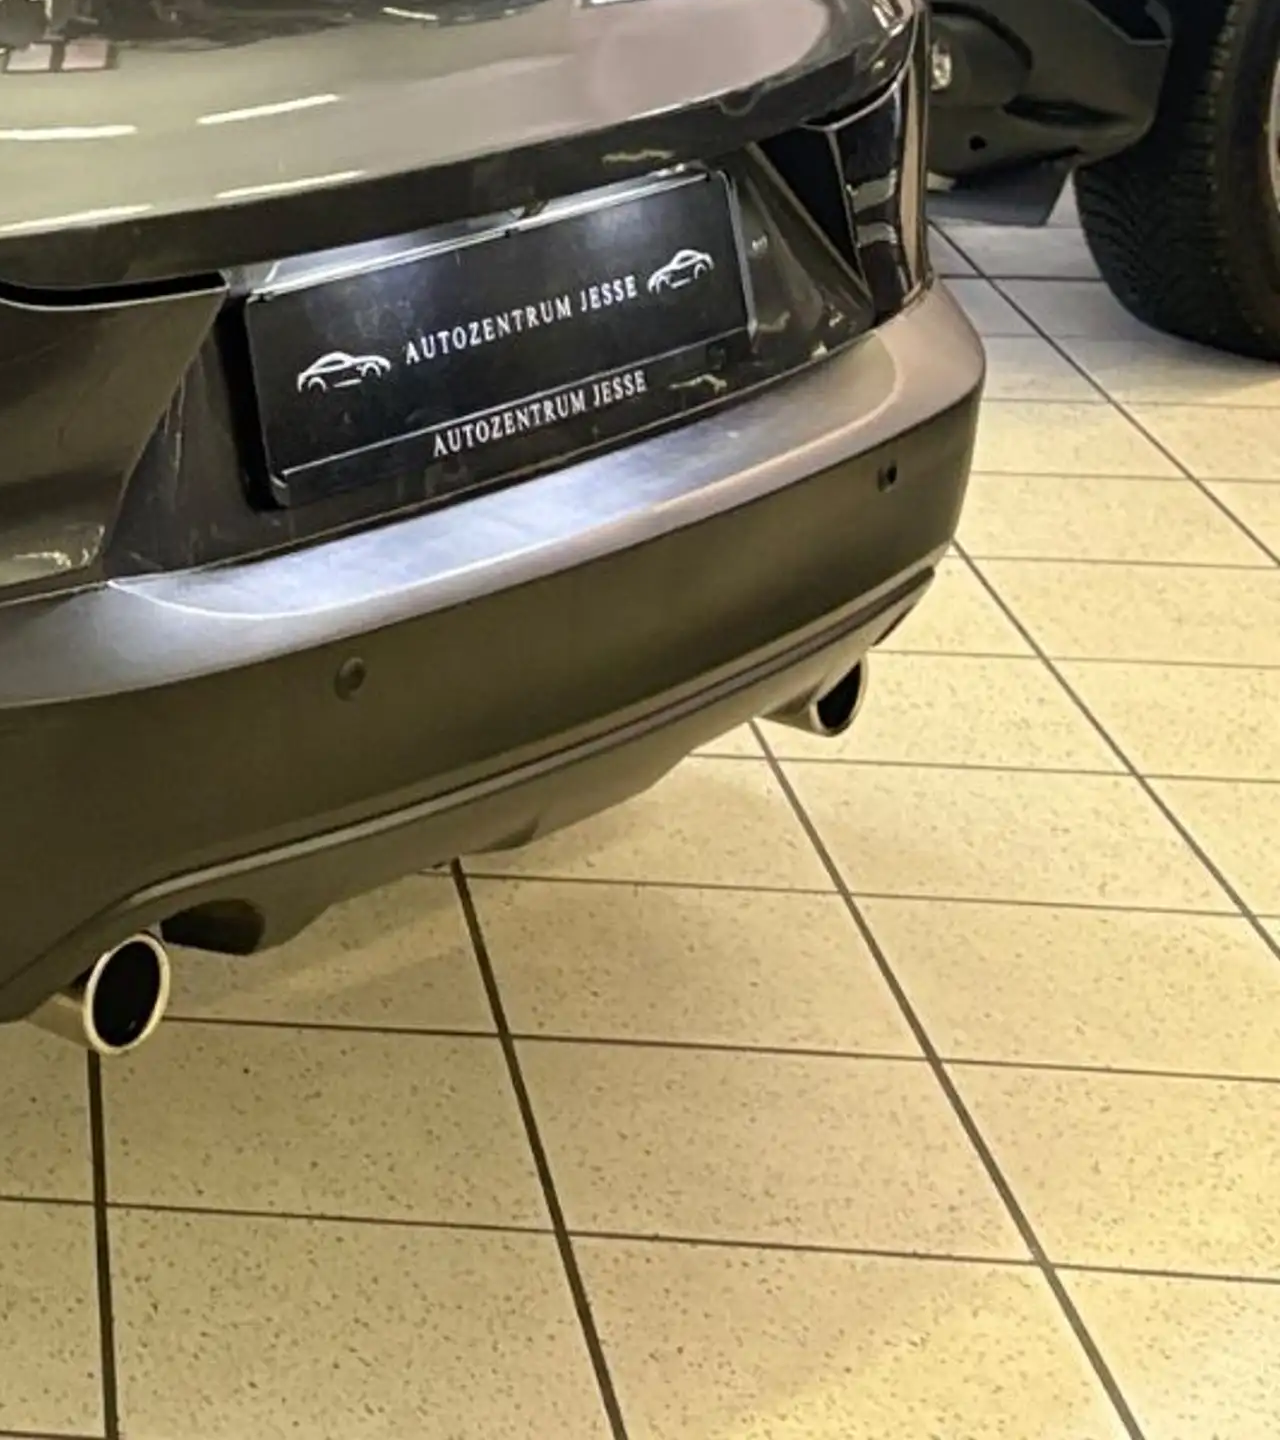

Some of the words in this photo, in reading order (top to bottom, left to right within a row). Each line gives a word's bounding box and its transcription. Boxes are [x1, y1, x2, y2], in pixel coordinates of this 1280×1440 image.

[405, 295, 572, 364] AUTOZENTRUM
[580, 275, 637, 312] JESSE
[433, 390, 586, 457] AUTOZENTRUM
[592, 370, 647, 407] JESSE
